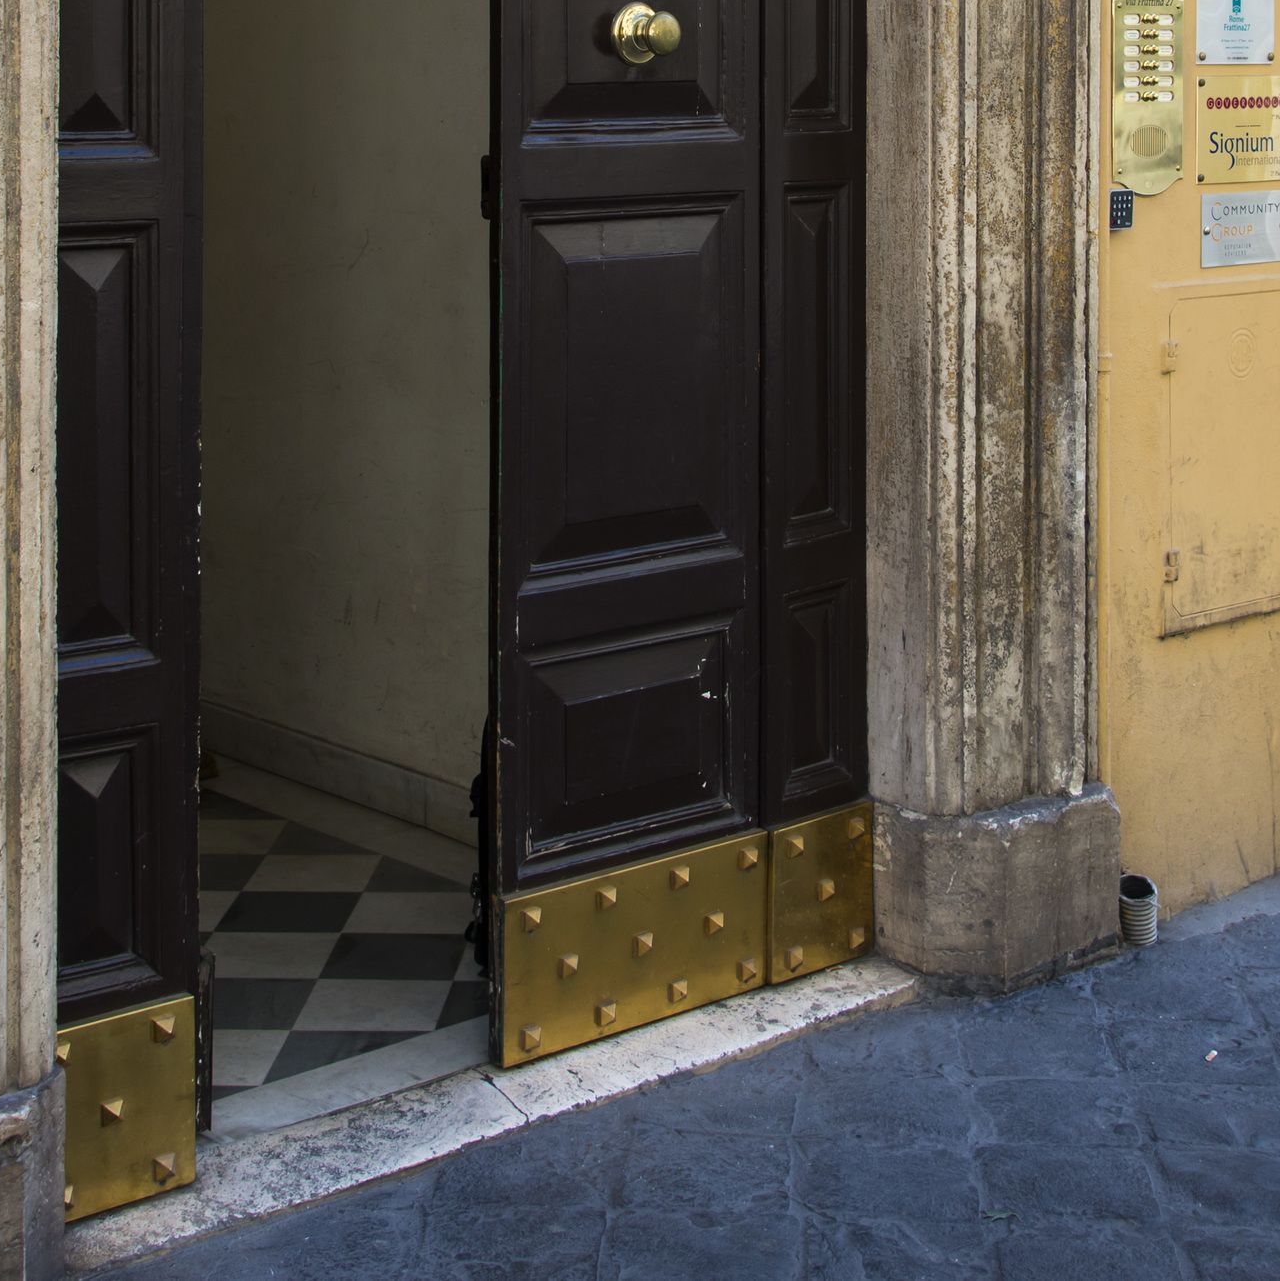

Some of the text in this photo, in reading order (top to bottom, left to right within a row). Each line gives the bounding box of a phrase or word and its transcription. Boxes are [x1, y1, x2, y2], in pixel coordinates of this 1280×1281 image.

[1209, 131, 1274, 170] Signium
[1211, 202, 1280, 221] COMMUNITY
[1211, 222, 1253, 242] GROUP
